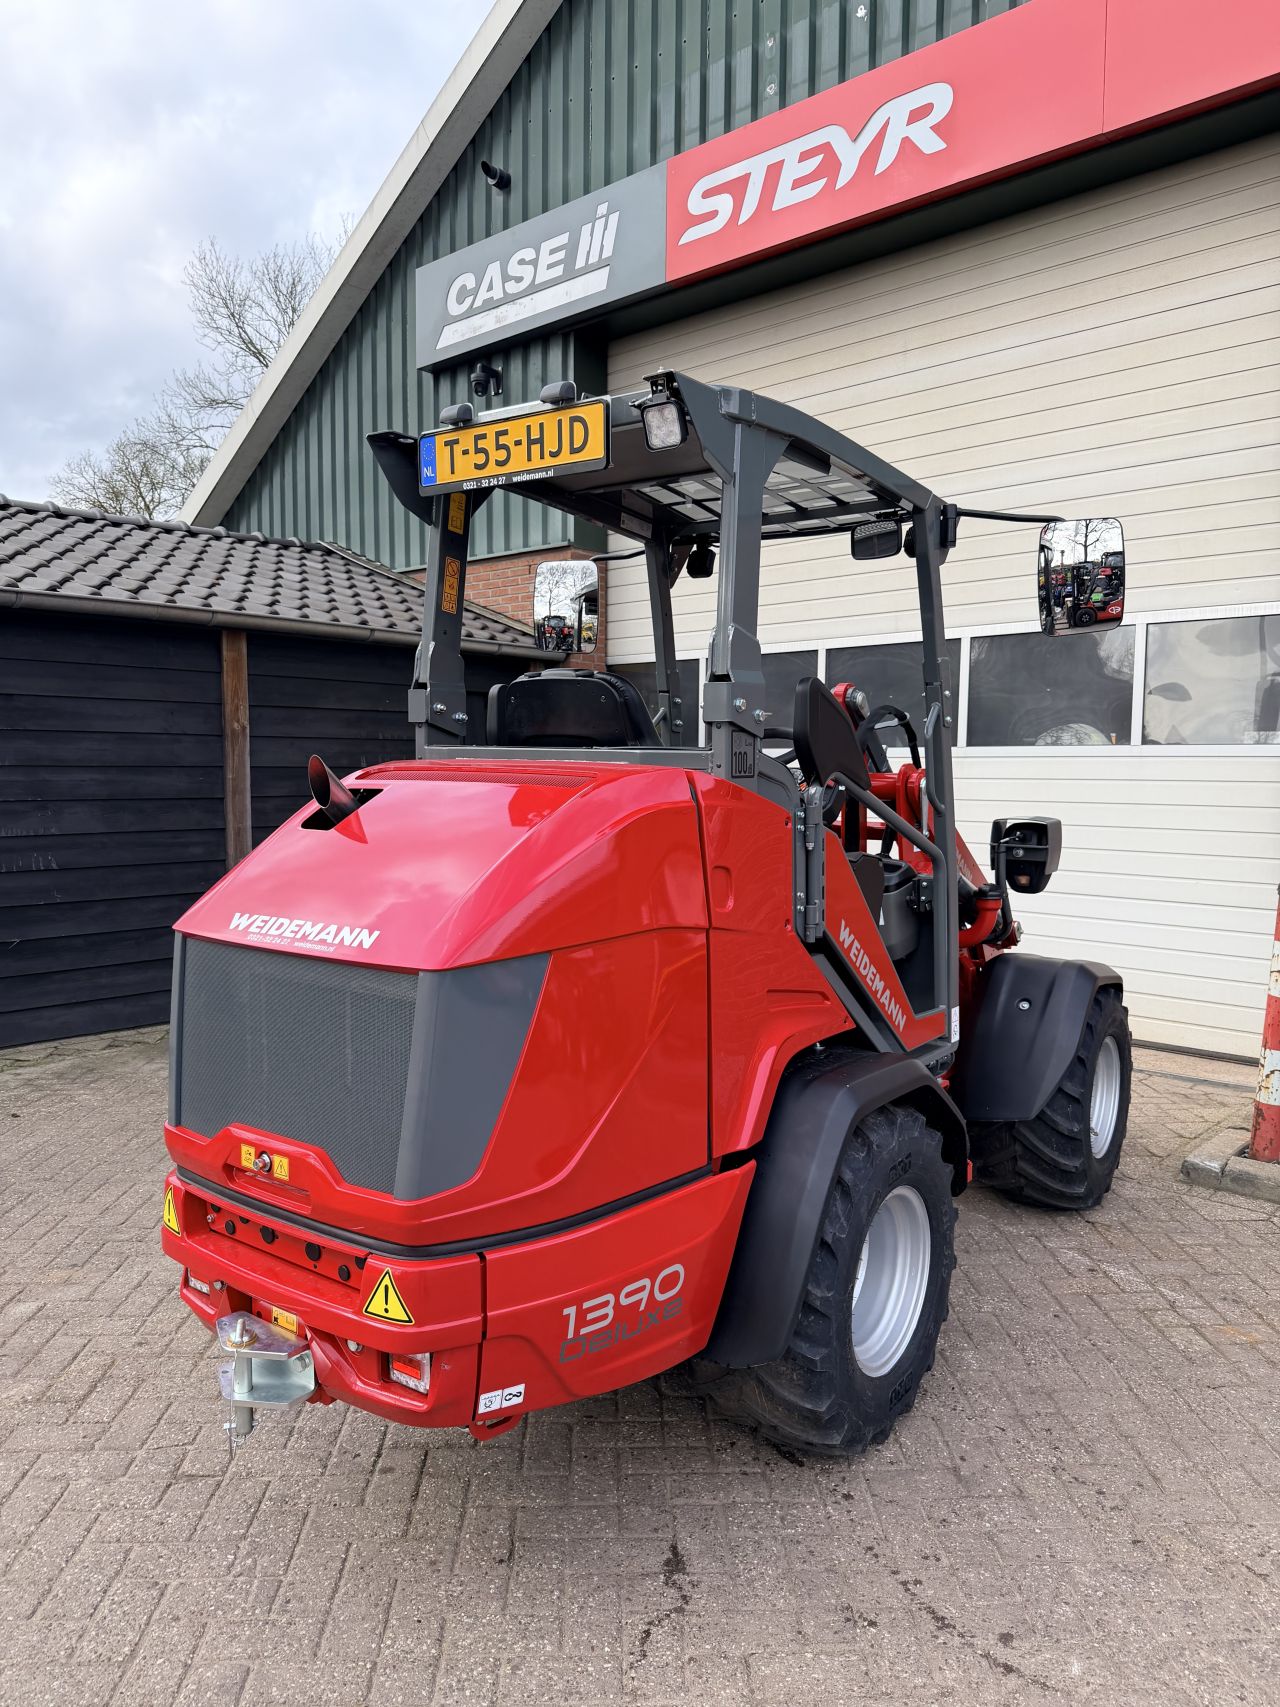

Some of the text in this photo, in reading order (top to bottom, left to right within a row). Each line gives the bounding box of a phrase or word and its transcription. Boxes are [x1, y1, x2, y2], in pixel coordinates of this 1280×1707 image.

[678, 82, 954, 246] STEYR
[446, 231, 570, 316] CASE
[423, 466, 435, 478] NL
[443, 415, 590, 475] T-55-HJD
[462, 482, 477, 490] 0321
[489, 478, 498, 486] 24
[498, 476, 506, 485] 27
[512, 469, 554, 483] weidemann.nl
[733, 751, 748, 774] 100
[229, 912, 381, 949] WEIDEMANN
[839, 918, 907, 1033] WEIDEMANN
[559, 1297, 683, 1364] Deluxe
[562, 1263, 685, 1340] 1390
